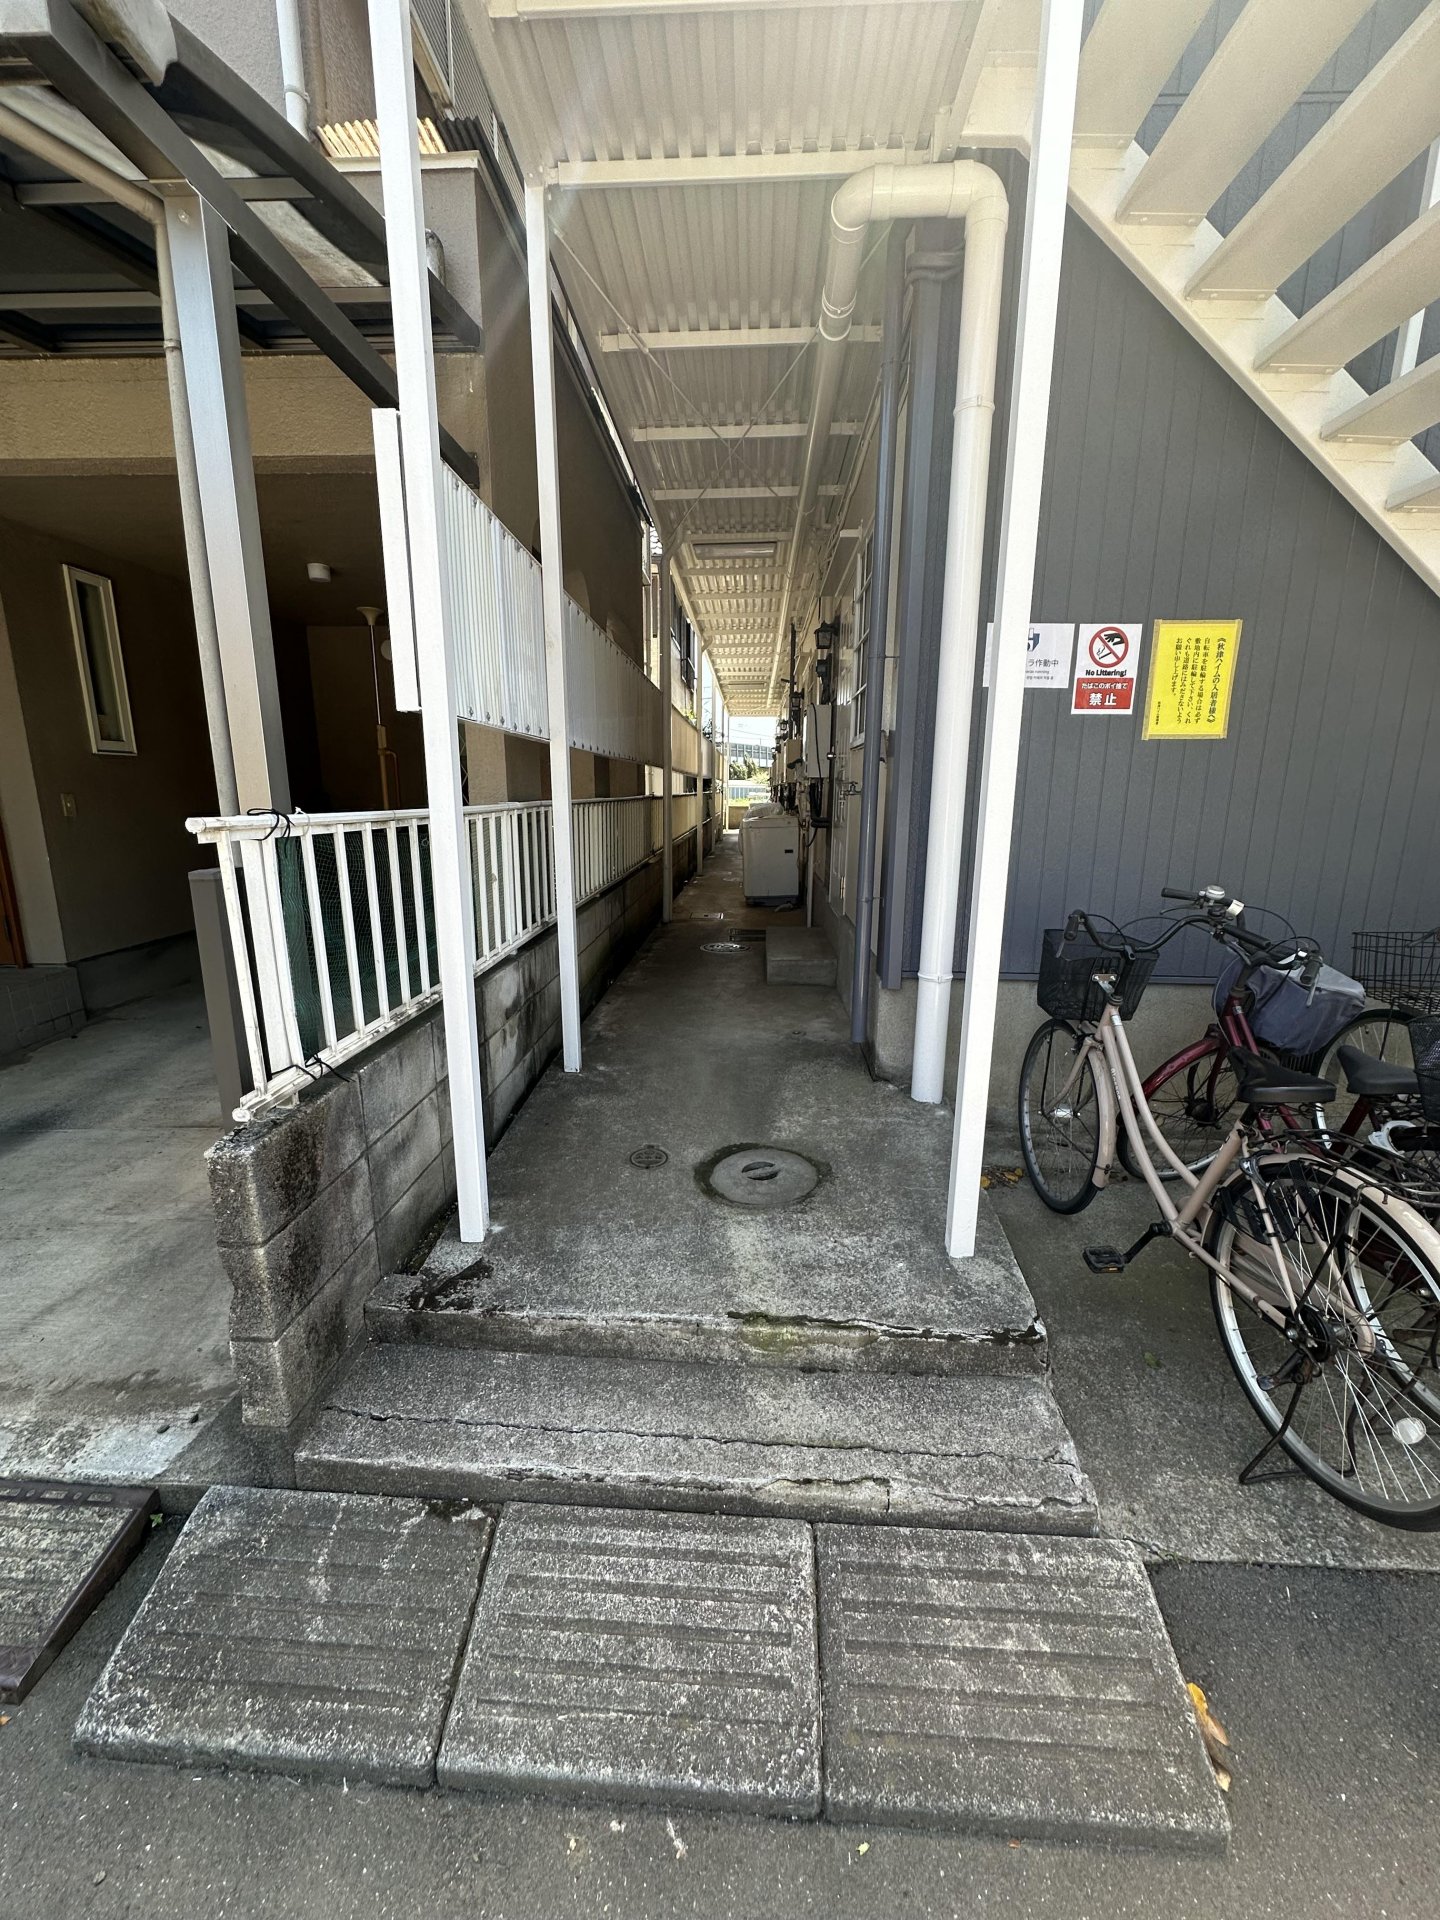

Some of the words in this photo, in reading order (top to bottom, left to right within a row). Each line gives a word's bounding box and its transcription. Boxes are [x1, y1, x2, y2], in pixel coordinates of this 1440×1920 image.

[1026, 658, 1059, 667] ラ作動中
[1096, 669, 1127, 677] Littering!
[1081, 682, 1129, 690] たばこのポイ捨て
[1089, 692, 1117, 706] 禁止
